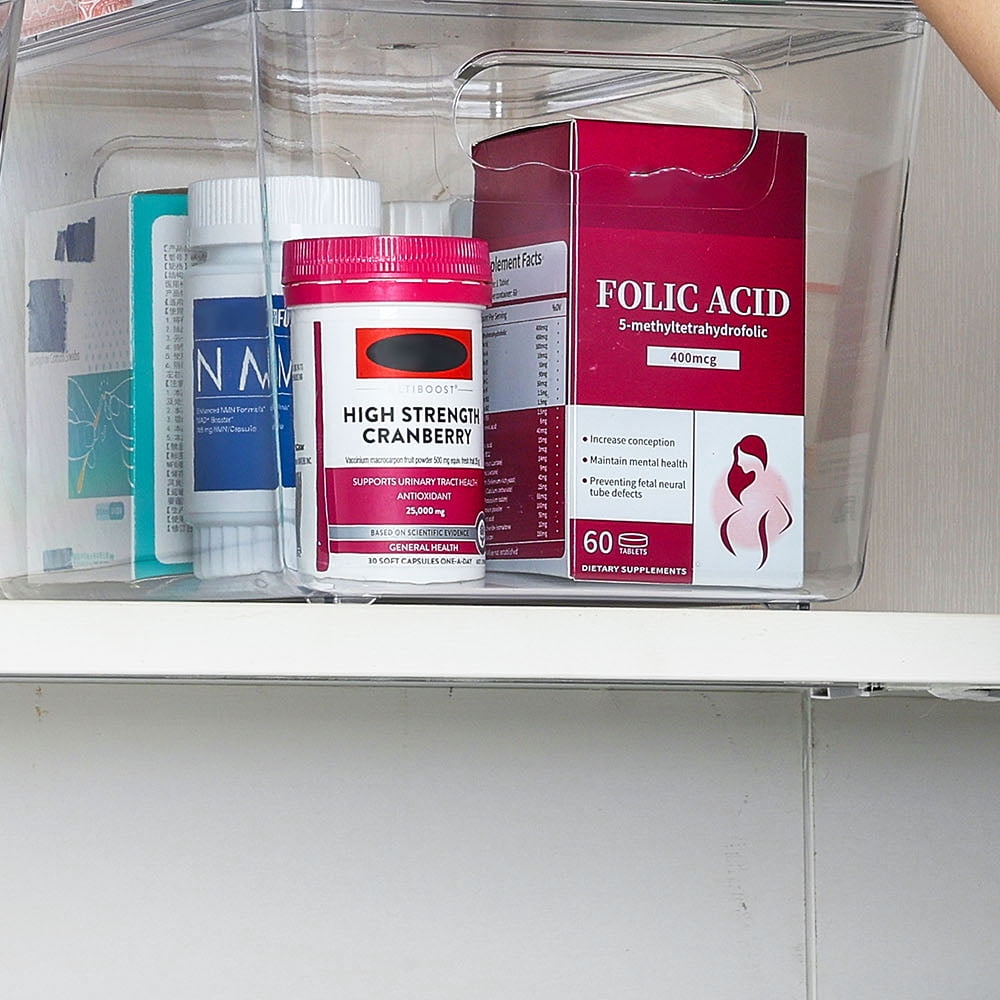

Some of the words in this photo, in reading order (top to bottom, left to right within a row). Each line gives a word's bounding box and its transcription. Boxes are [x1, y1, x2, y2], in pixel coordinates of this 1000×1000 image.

[521, 251, 543, 268] Facts
[596, 279, 699, 314] FOLIC
[706, 285, 791, 318] ACID
[618, 318, 768, 339] 5-methyltetrahydrofolic
[670, 351, 718, 368] 400mcg
[343, 406, 395, 423] HIGH
[401, 406, 480, 425] STRENGTH
[362, 427, 472, 445] CRANBERRY
[590, 434, 627, 445] Increase
[627, 437, 676, 448] conception
[590, 455, 628, 466] Maintain
[629, 457, 659, 467] mental
[660, 458, 688, 469] health
[352, 477, 397, 486] SUPPORTS
[398, 477, 436, 486] URINARY
[437, 477, 459, 487] TRACT
[589, 476, 637, 490] Preventing
[638, 478, 658, 489] fetal
[658, 480, 686, 490] neural
[396, 491, 452, 501] ANTIOXIDANT
[589, 488, 610, 498] tube
[611, 488, 643, 499] defects
[405, 506, 434, 516] 25,000
[434, 509, 446, 518] mg
[370, 529, 393, 537] BASED
[394, 529, 406, 537] ON
[407, 529, 443, 537] SCIENTIFIC
[444, 529, 470, 537] EVIDENCE
[388, 543, 430, 552] GENERAL
[431, 543, 459, 552] HEALTH
[583, 530, 613, 554] 60
[619, 547, 648, 556] TABLETS
[378, 557, 400, 565] SOFT
[400, 557, 440, 565] CAPSULES
[581, 564, 620, 574] DIETARY
[620, 565, 687, 576] SUPPLEMENTS
